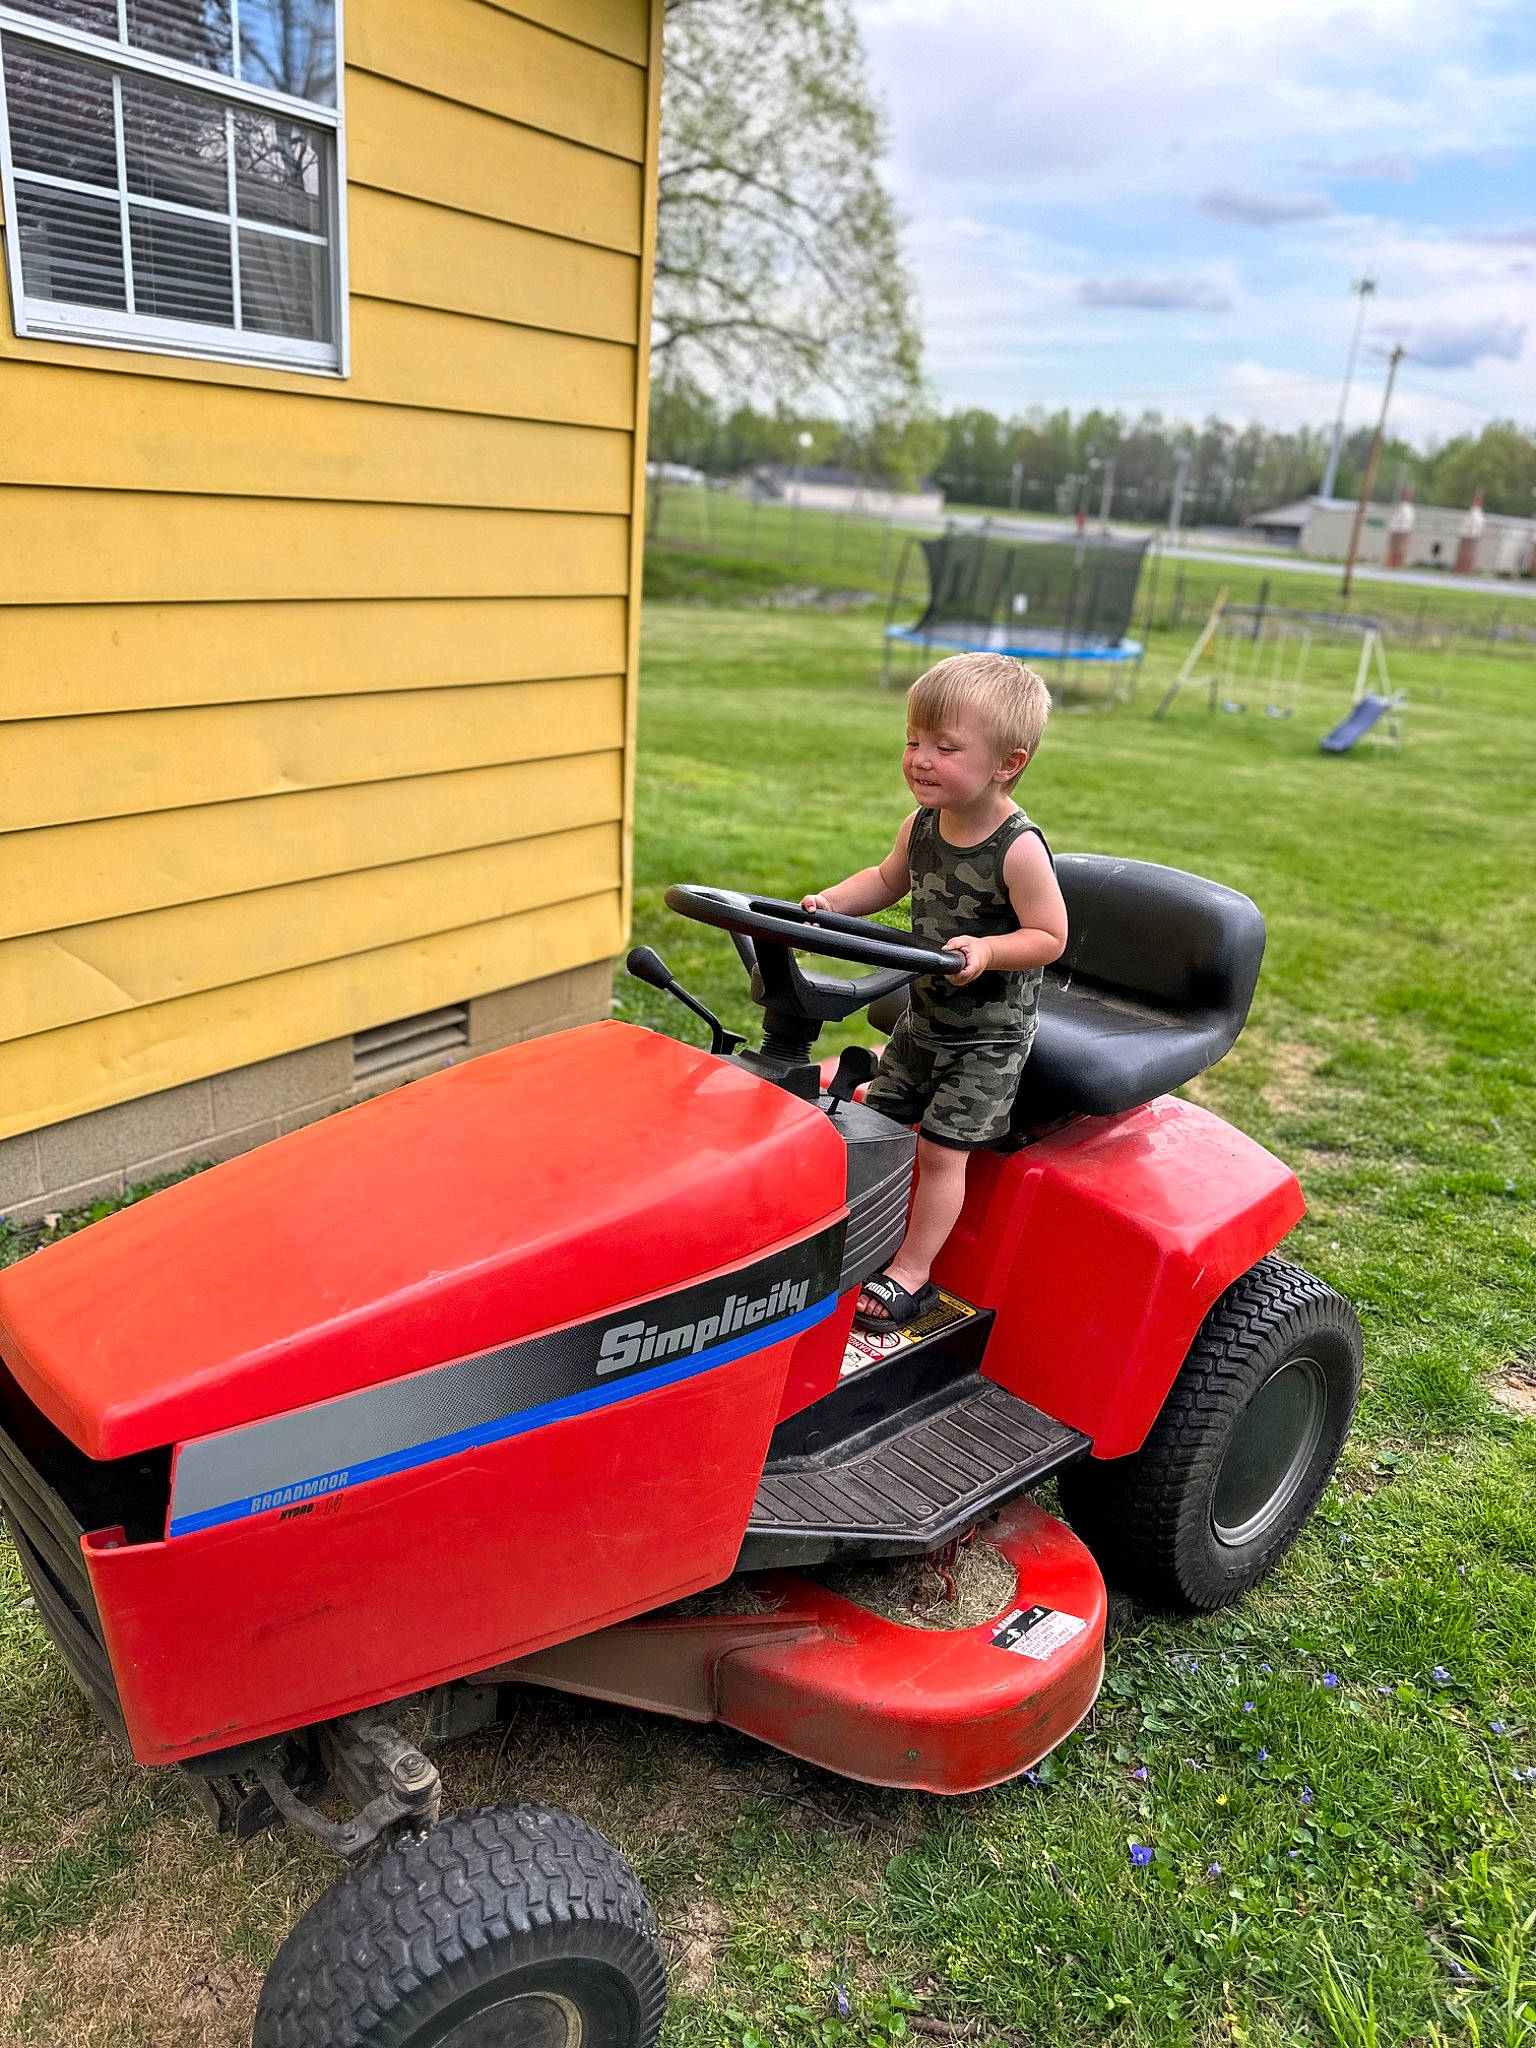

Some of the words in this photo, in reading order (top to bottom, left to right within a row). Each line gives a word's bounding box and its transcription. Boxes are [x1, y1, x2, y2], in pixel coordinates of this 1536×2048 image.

[864, 1282, 892, 1302] PUMA
[596, 1278, 810, 1376] Simplicity
[251, 1471, 349, 1513] BROADMOOR
[279, 1502, 315, 1521] HYDRO
